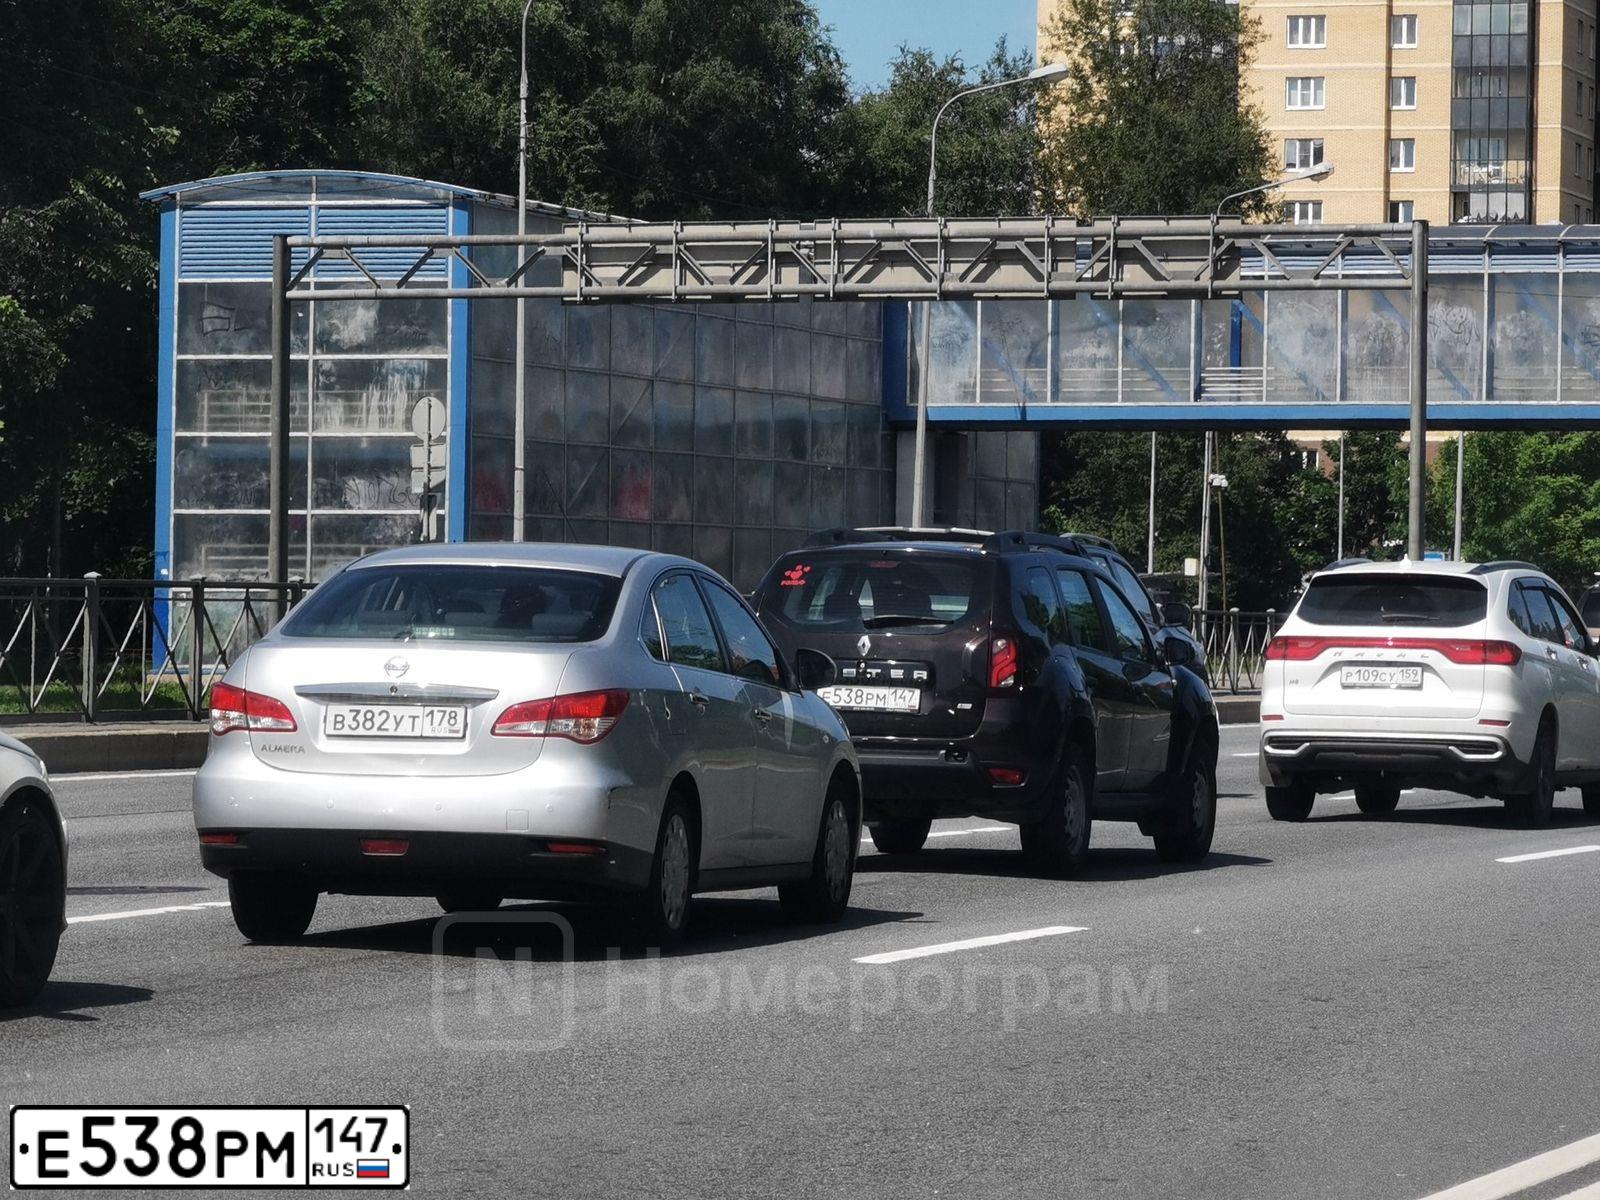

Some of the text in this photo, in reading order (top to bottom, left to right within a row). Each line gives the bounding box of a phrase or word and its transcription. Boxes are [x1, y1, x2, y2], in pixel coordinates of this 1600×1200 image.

[1345, 668, 1418, 683] Р109СУ 159
[822, 687, 915, 706] Е538РМ 147
[333, 709, 458, 732] В382УТ 178
[260, 744, 306, 754] ALMERA
